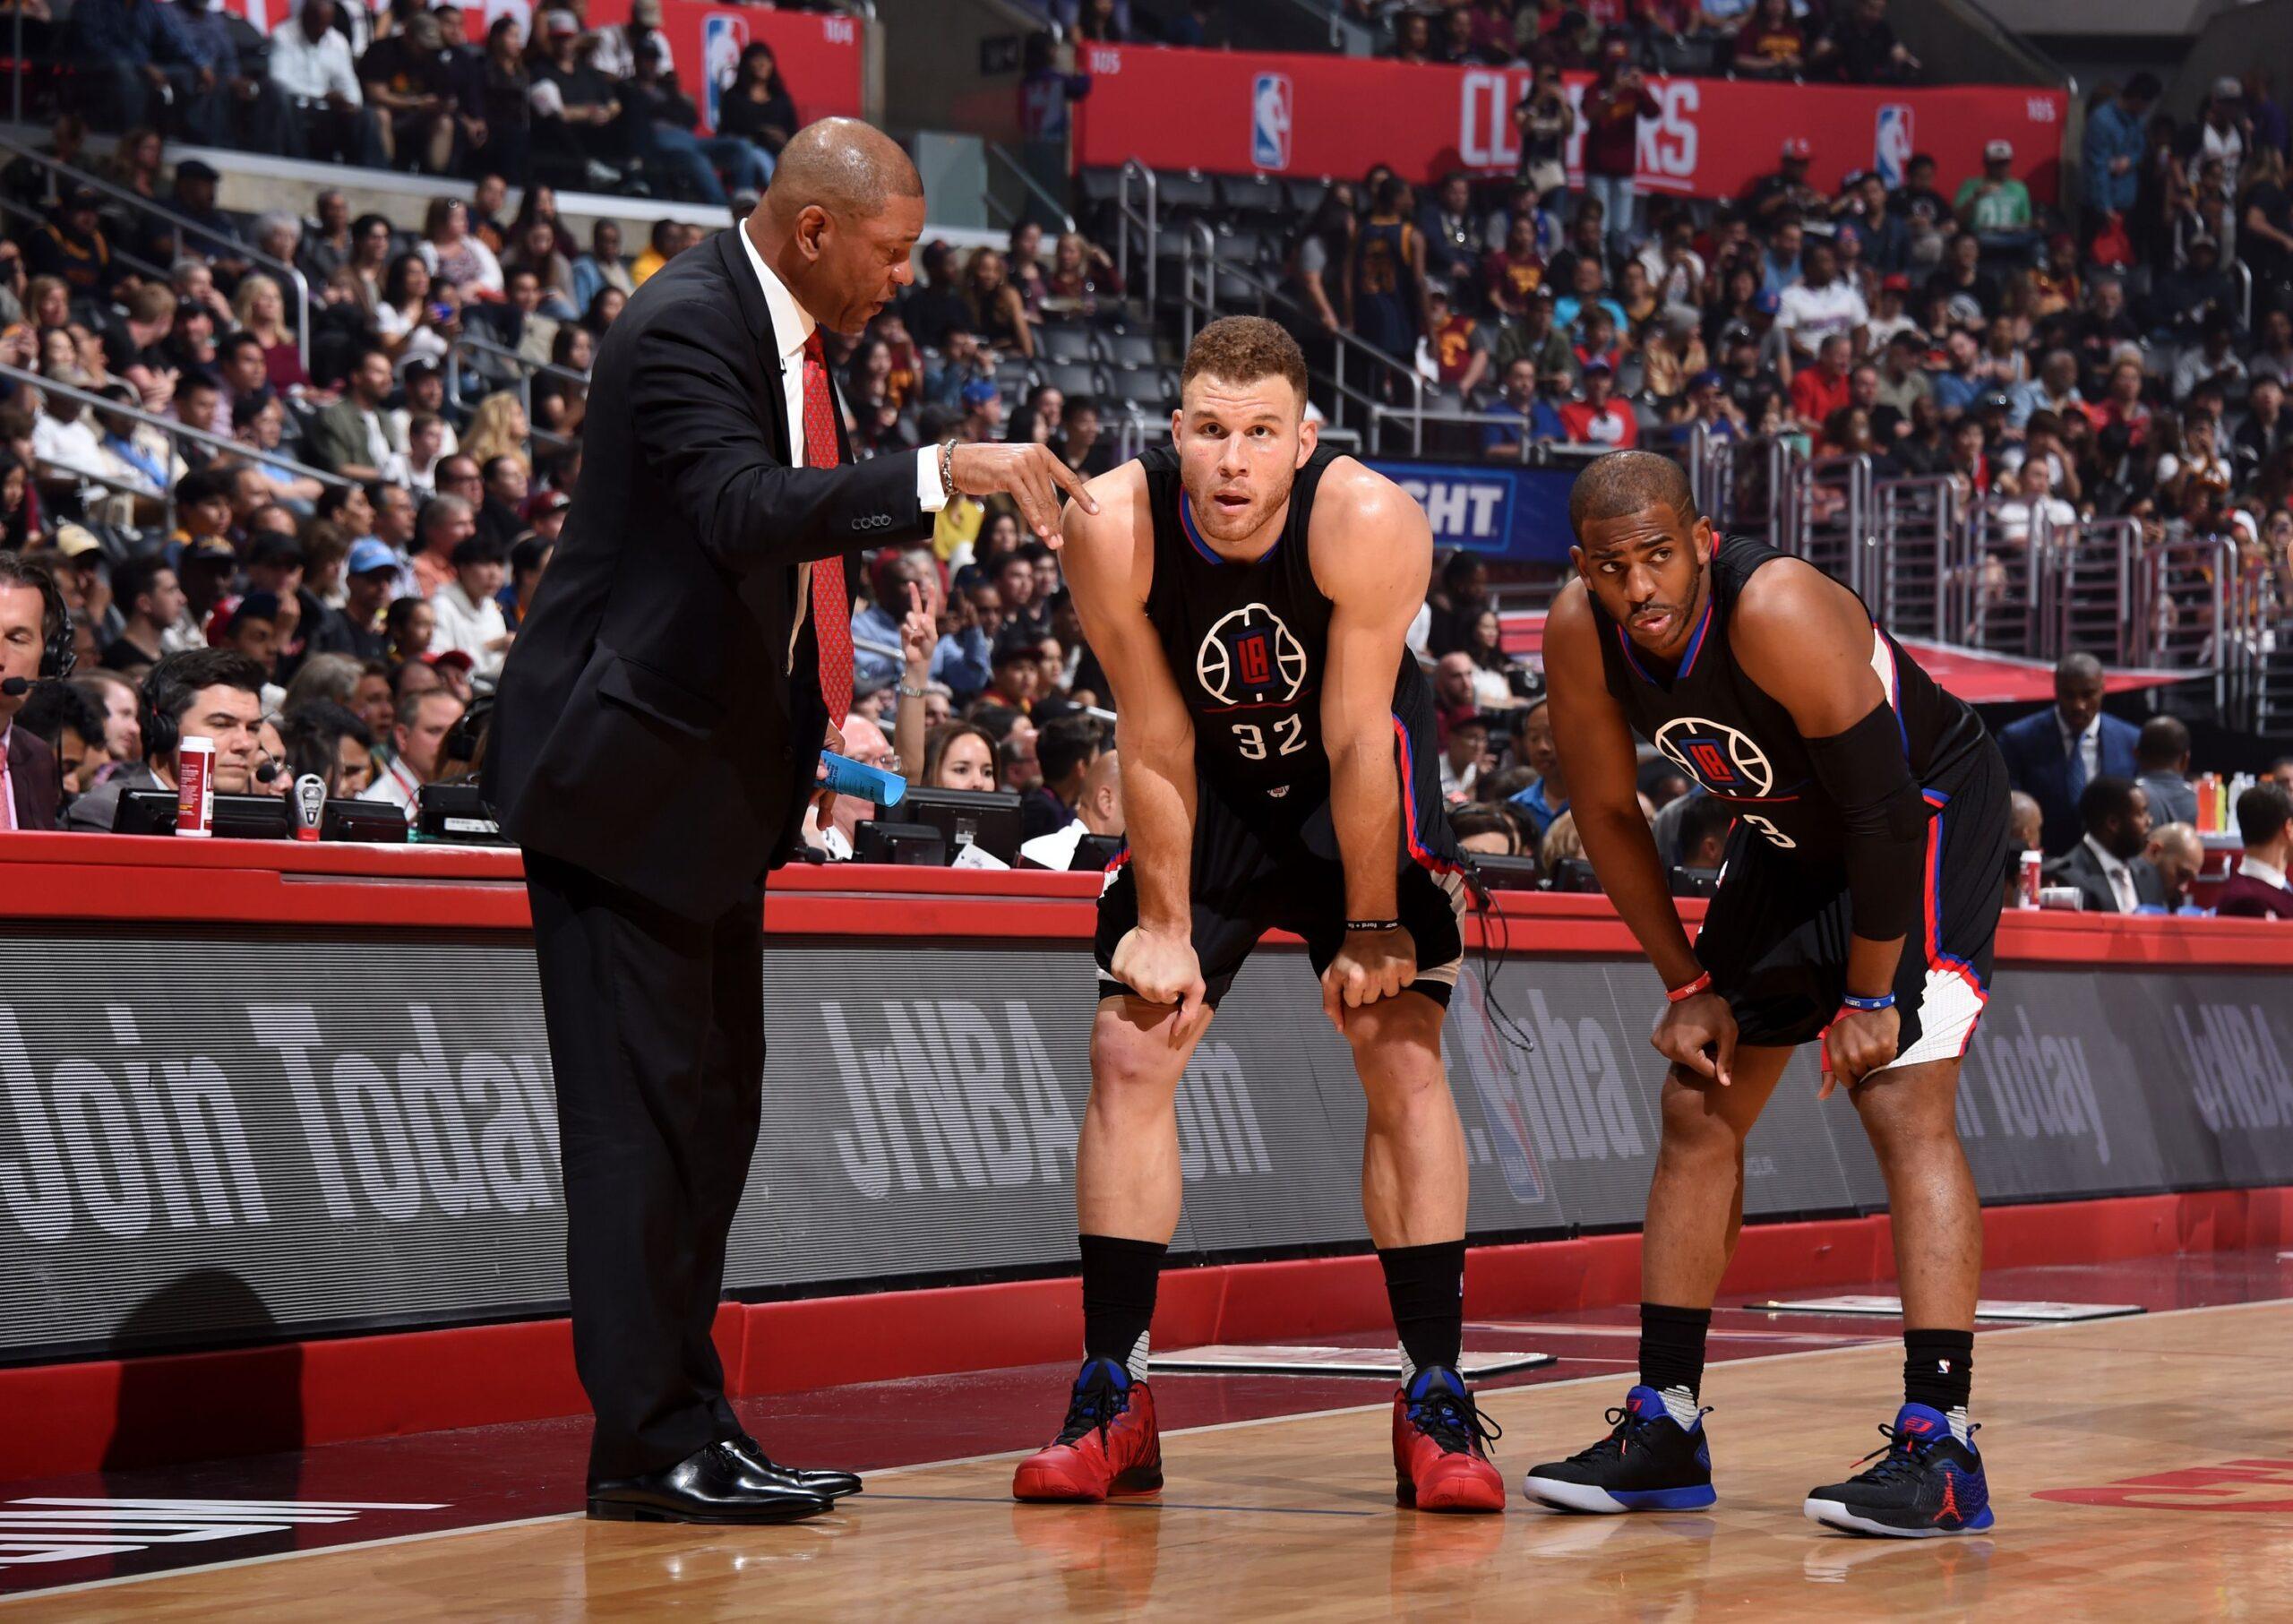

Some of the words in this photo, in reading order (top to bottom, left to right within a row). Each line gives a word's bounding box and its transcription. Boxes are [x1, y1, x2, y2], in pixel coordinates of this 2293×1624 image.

[1236, 635, 1271, 684] LA
[1232, 713, 1308, 760] 32
[1688, 744, 1735, 782] LA
[1742, 813, 1797, 849] 3
[1973, 1004, 2111, 1165] Today
[0, 1002, 271, 1243] Join
